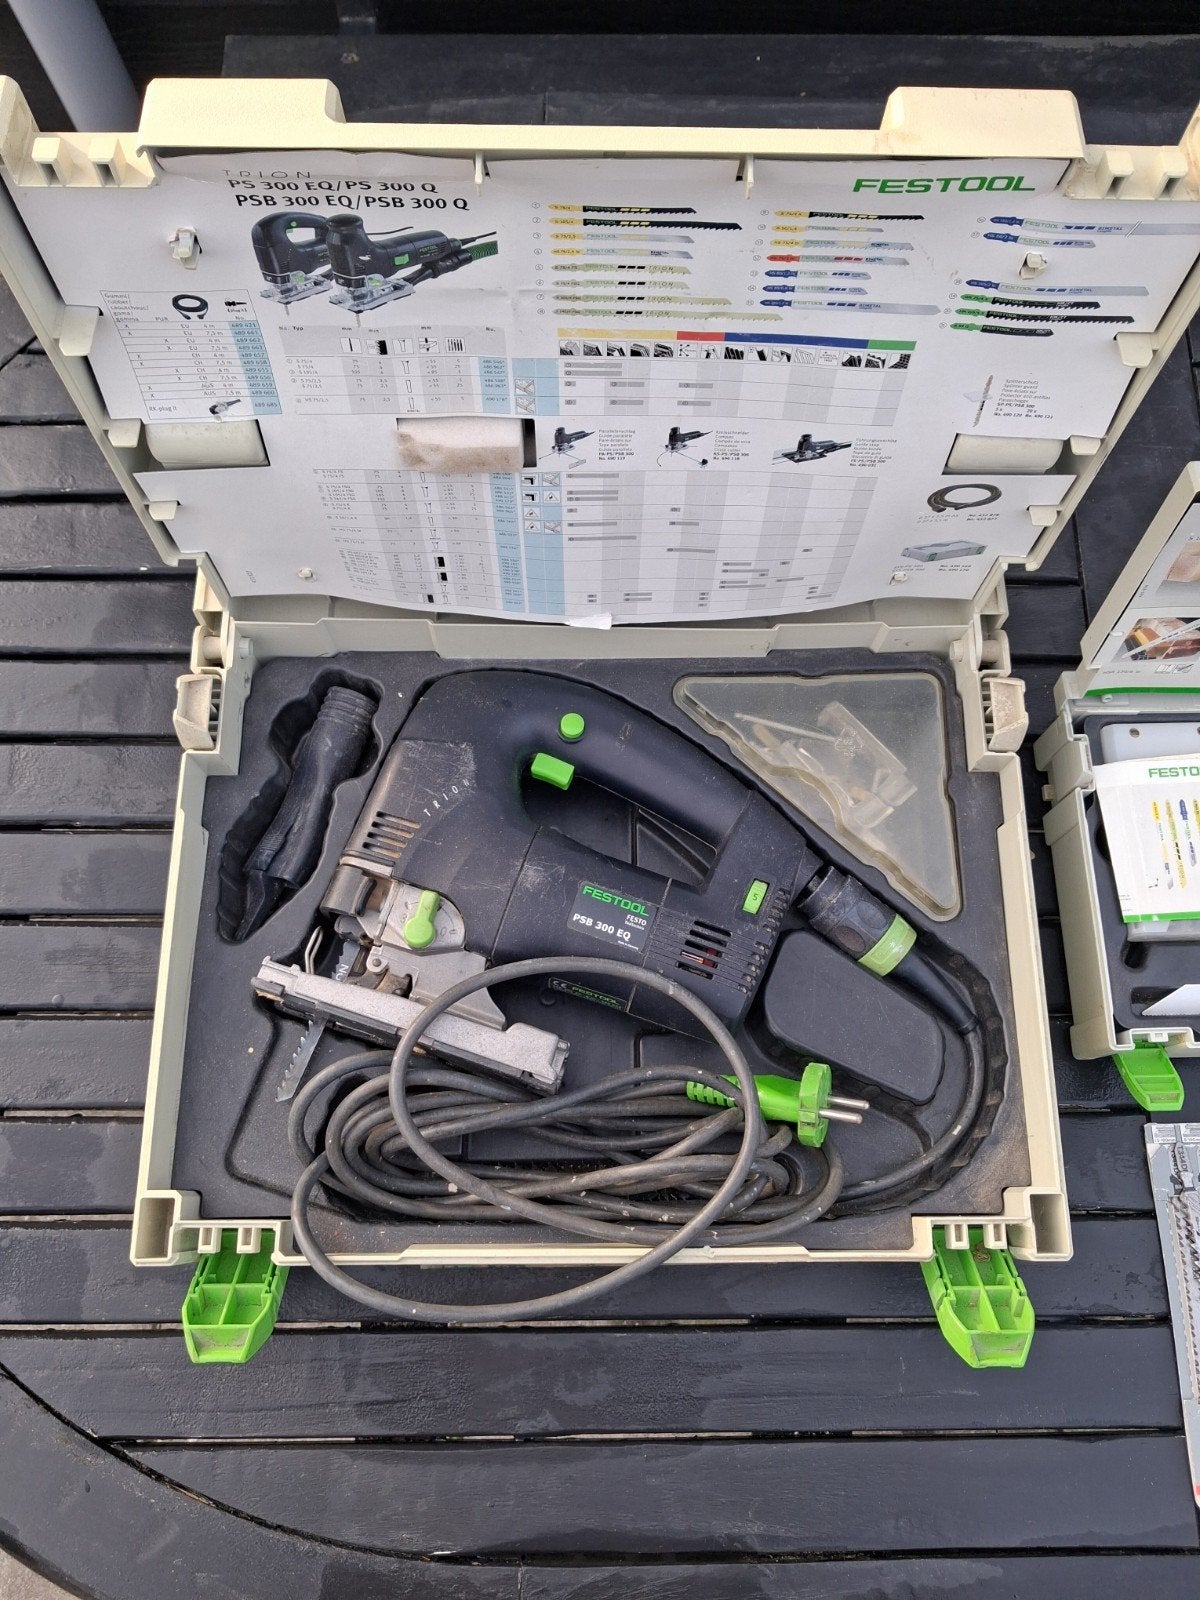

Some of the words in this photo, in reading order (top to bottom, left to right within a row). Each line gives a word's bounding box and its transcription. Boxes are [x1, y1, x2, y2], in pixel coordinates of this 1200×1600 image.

[227, 179, 256, 189] PS
[260, 181, 300, 191] 300
[304, 180, 372, 192] EQ/PS
[377, 181, 416, 192] 300
[420, 182, 439, 194] Q
[853, 175, 1036, 194] FESTOOL
[235, 194, 278, 207] PSB
[281, 195, 320, 207] 300
[324, 194, 405, 211] EQ/PSB
[409, 197, 448, 209] 300
[452, 197, 470, 212] Q
[1024, 219, 1059, 229] FESTOOL
[1019, 236, 1051, 245] FESTOOL
[1000, 283, 1033, 291] FESTOOL
[1147, 766, 1200, 779] FESTO
[423, 778, 470, 817] TRION
[582, 885, 650, 917] FESTOOL
[572, 913, 594, 927] PSB
[594, 921, 615, 934] 300
[616, 929, 631, 942] EQ
[626, 914, 647, 926] FESTO
